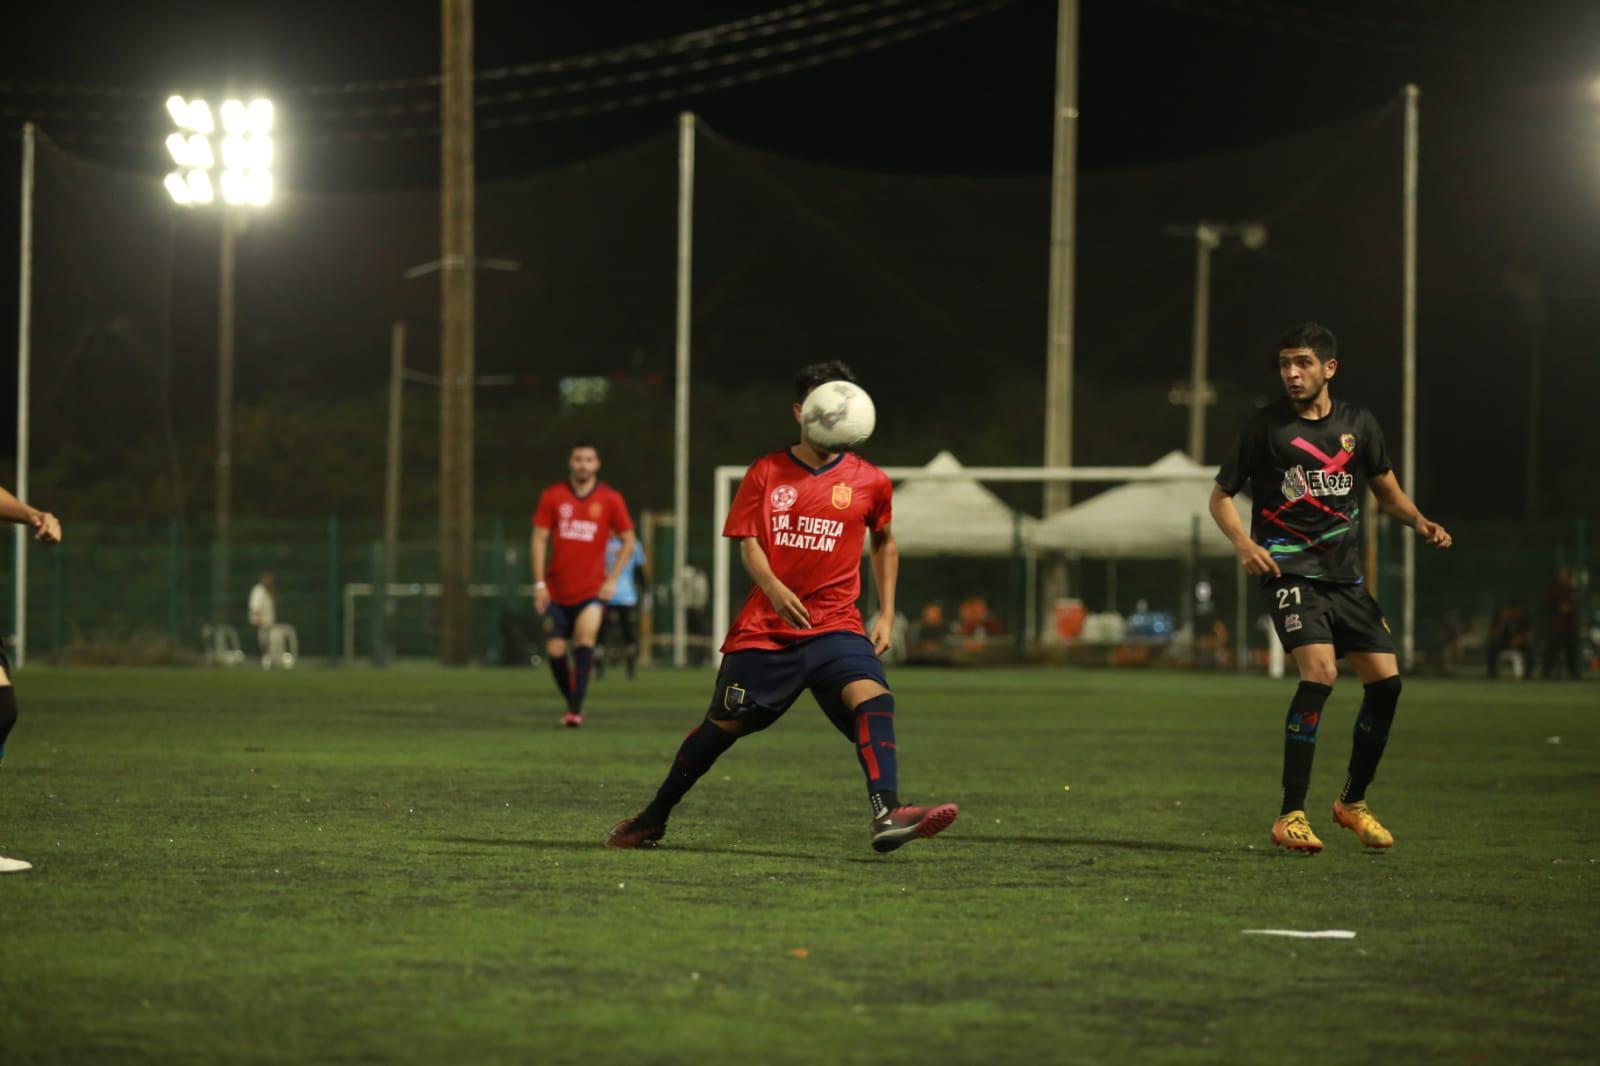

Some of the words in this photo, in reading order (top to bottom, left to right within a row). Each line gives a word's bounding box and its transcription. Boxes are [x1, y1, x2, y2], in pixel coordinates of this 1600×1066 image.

[1307, 470, 1353, 491] Elota
[797, 516, 844, 537] FUERZA
[1276, 586, 1301, 608] 21
